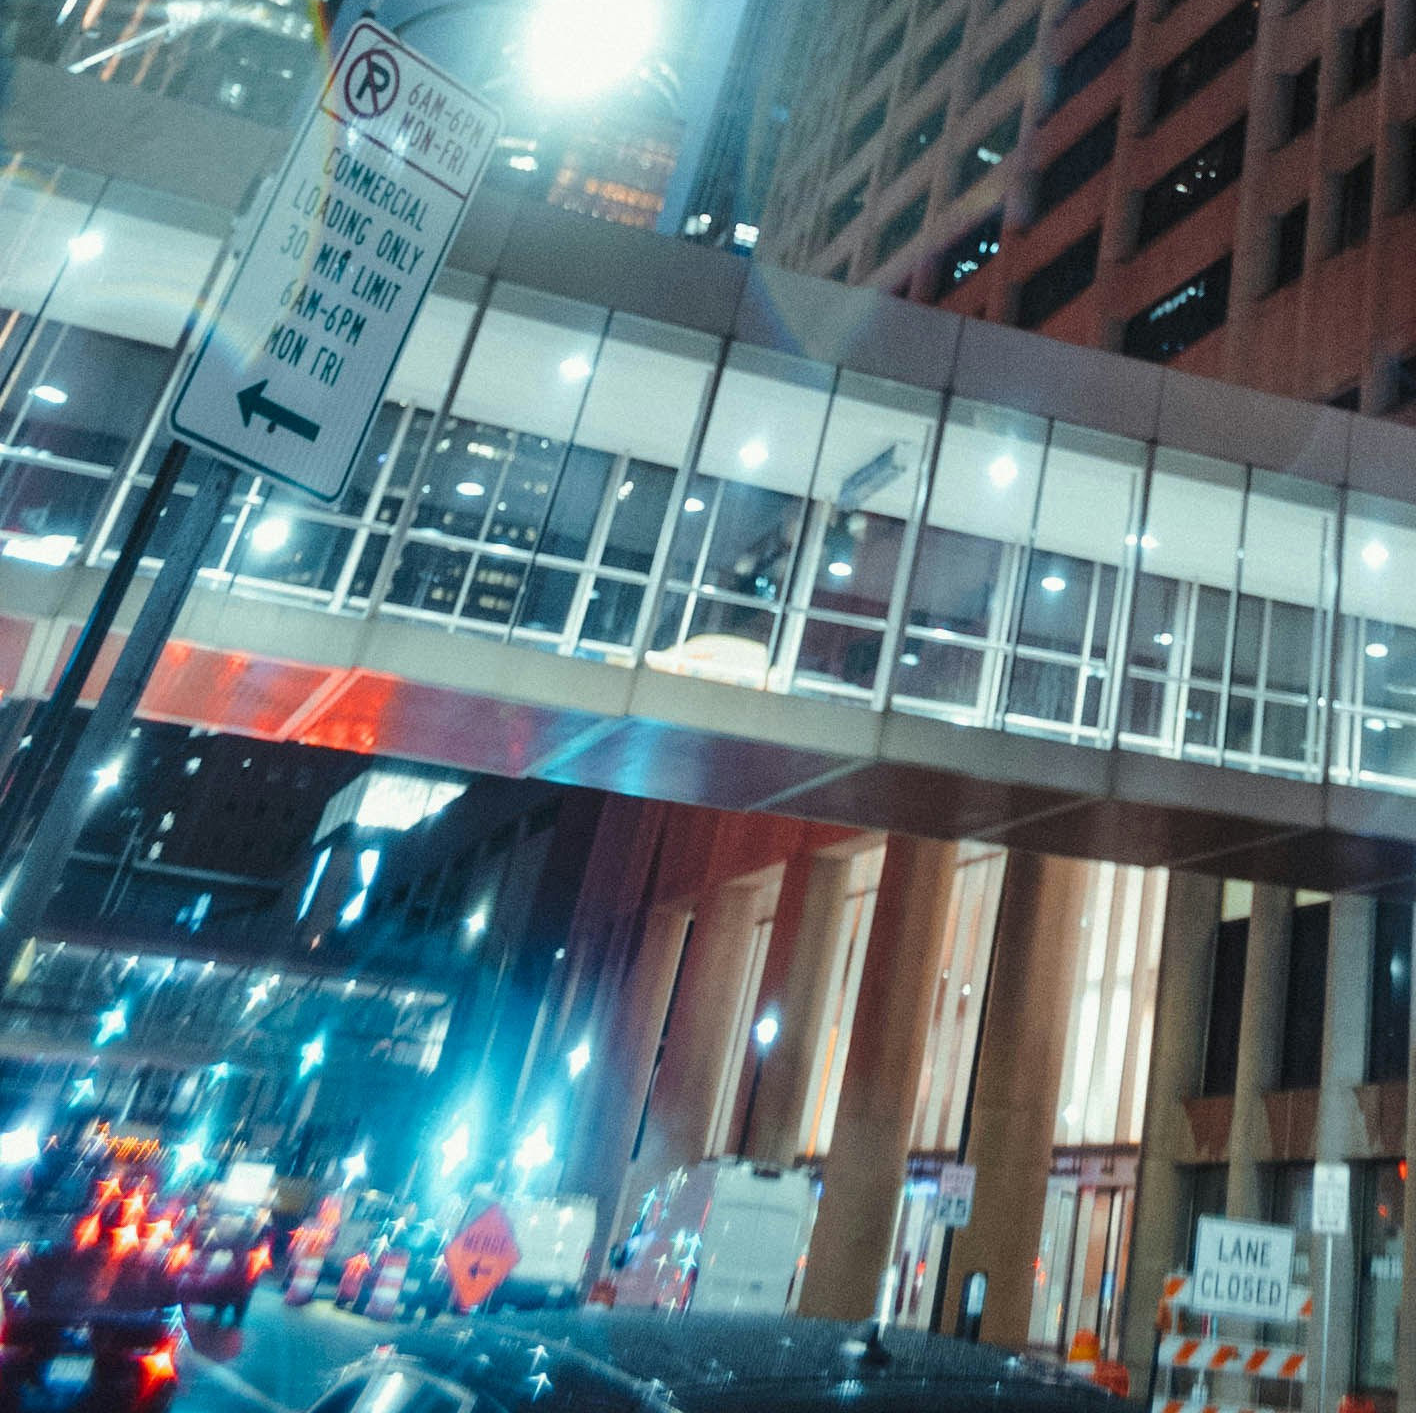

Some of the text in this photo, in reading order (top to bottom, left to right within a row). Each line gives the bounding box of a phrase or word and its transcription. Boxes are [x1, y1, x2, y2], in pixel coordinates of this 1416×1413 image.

[398, 111, 470, 175] MON-FRI
[407, 82, 486, 149] 6AM-6PM
[323, 147, 429, 233] COMMERCIAL
[292, 179, 425, 275] LOADING ONLY
[280, 224, 402, 313] 30 MIN LIMIT
[263, 322, 310, 368] MON
[280, 278, 367, 347] 6AM-6PM
[1218, 1236, 1272, 1269] LANE
[1201, 1268, 1282, 1306] CLOSED
